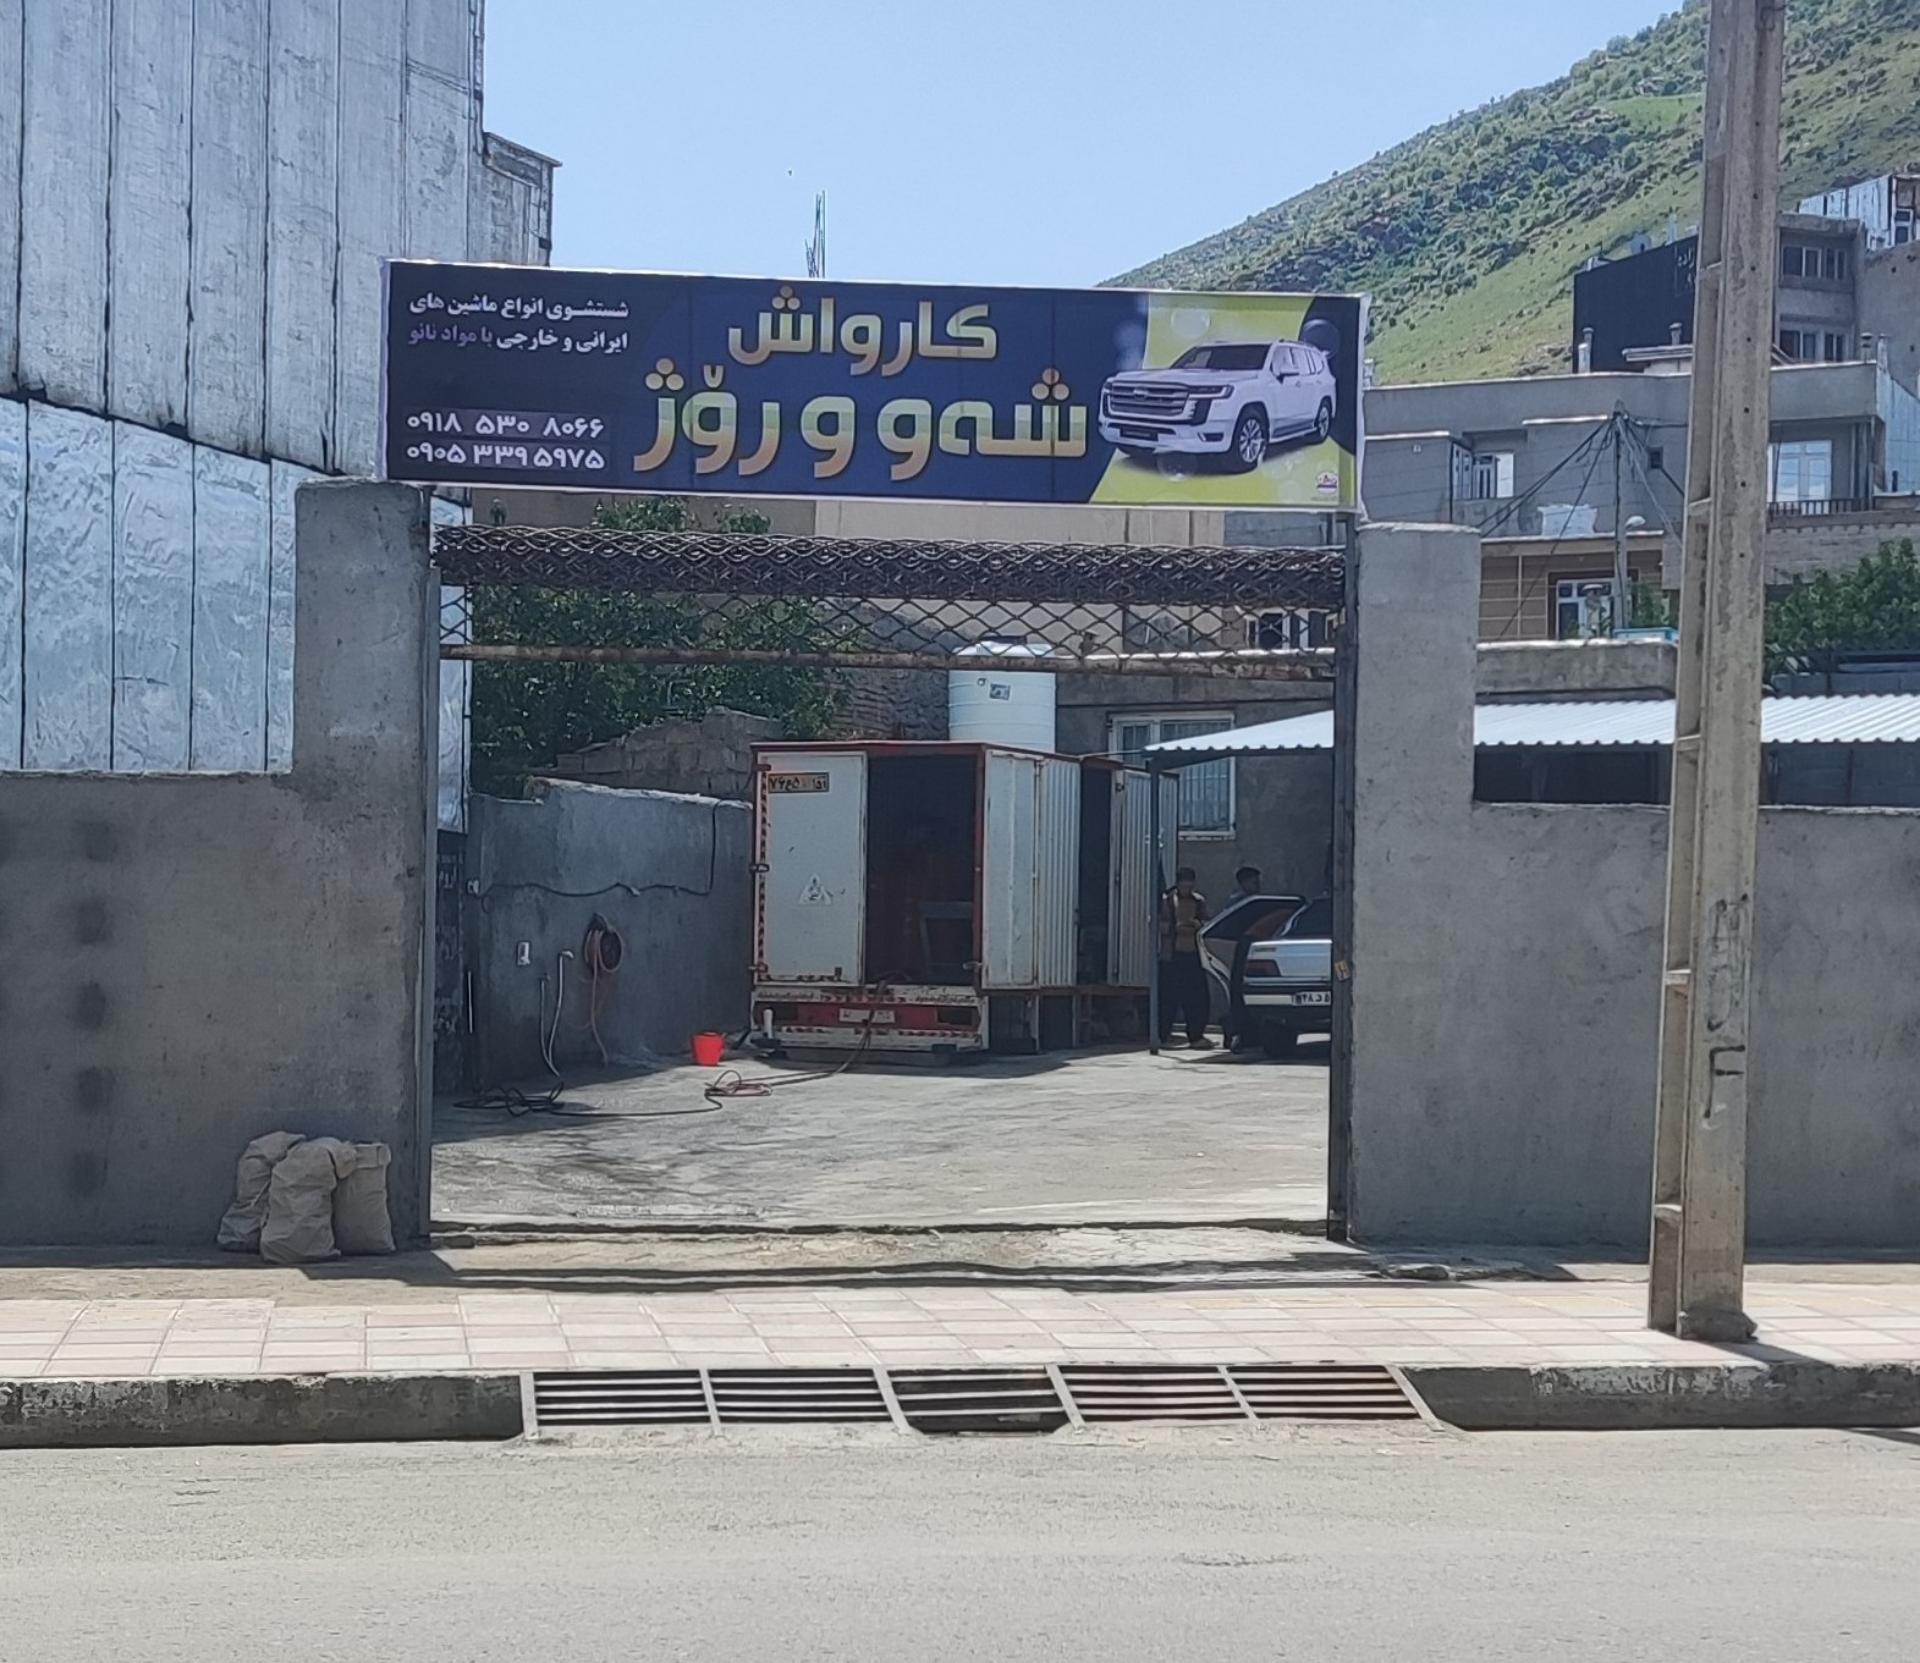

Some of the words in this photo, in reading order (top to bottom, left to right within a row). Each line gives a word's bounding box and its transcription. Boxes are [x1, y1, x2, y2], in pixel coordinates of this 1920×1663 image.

[409, 292, 445, 313] های
[447, 294, 498, 316] ماشین
[501, 297, 543, 319] انواع
[545, 300, 629, 321] شستشوی
[408, 323, 437, 344] نانو
[441, 324, 477, 346] مواد
[481, 326, 493, 348] با
[496, 328, 558, 350] خارجی
[728, 284, 998, 377] کارواش
[562, 336, 573, 352] و
[576, 331, 628, 353] ایرانی
[407, 411, 462, 432] ۰۹۱۸
[475, 414, 530, 435] ۵۳۰
[801, 396, 856, 479] و
